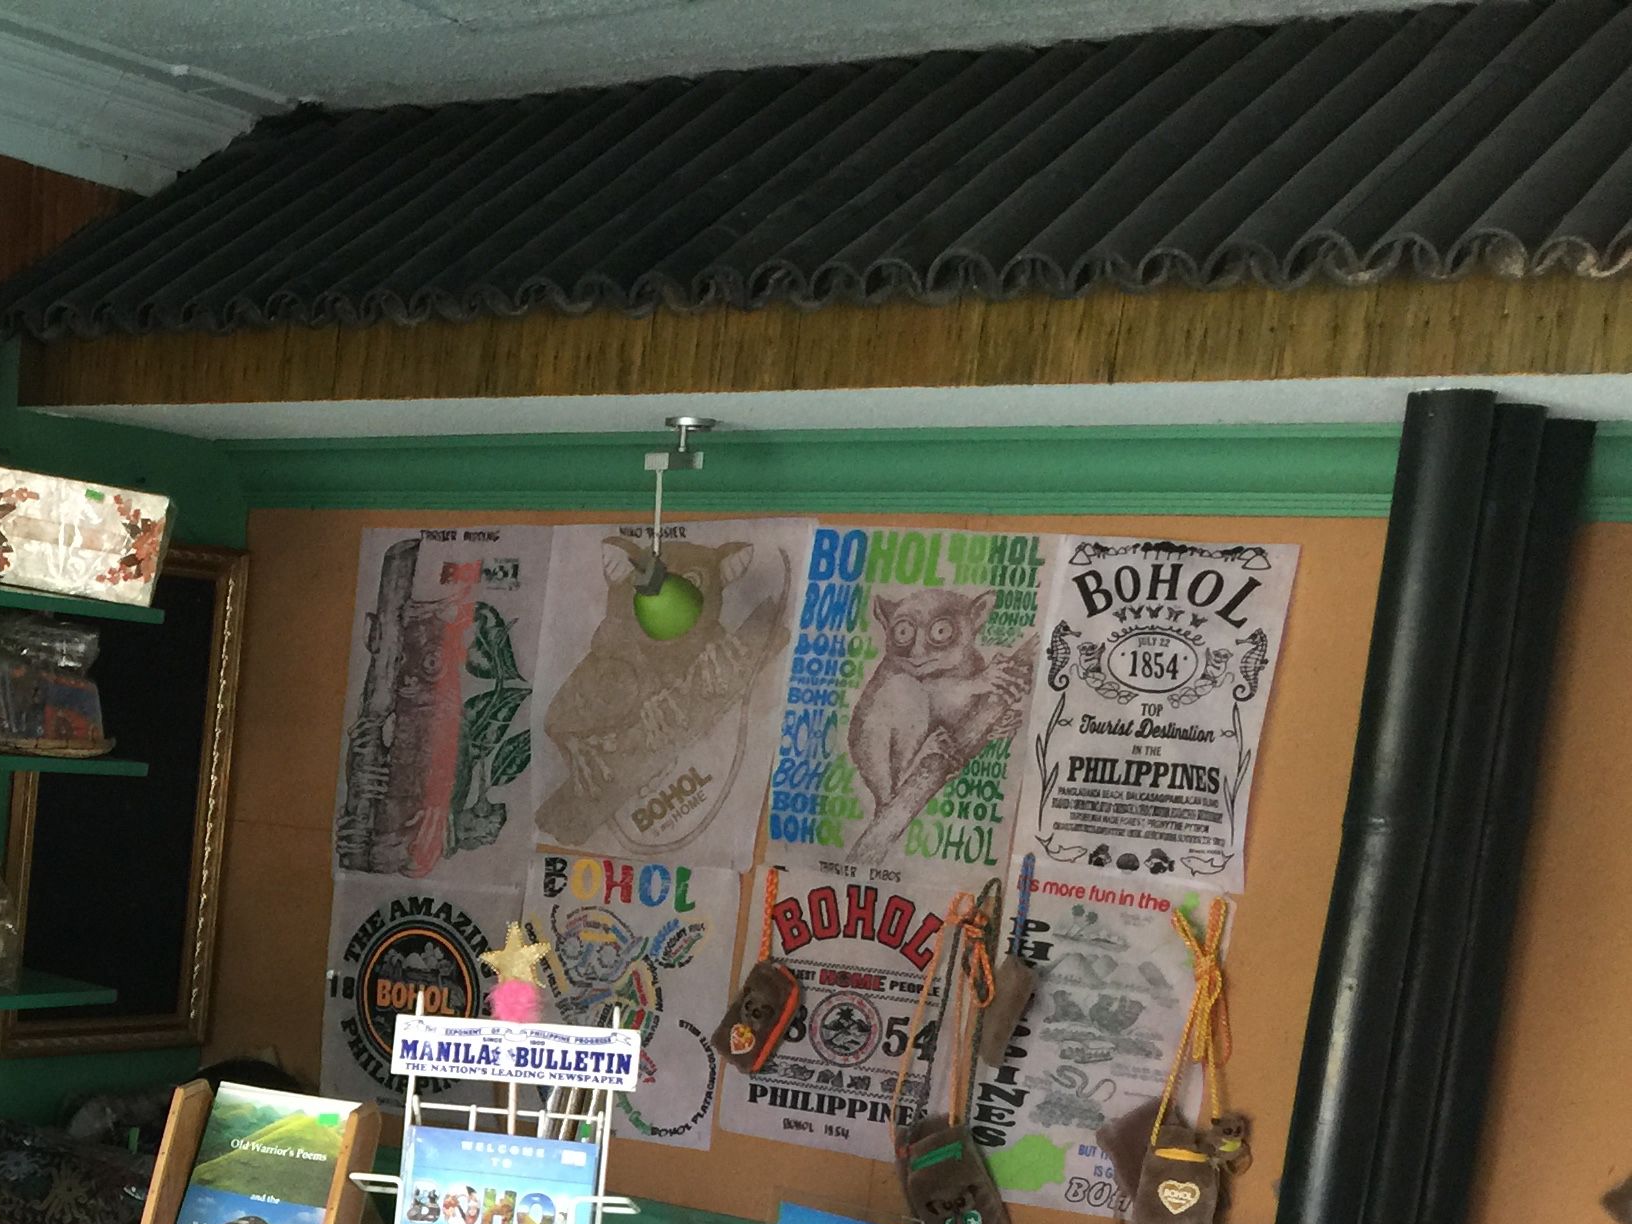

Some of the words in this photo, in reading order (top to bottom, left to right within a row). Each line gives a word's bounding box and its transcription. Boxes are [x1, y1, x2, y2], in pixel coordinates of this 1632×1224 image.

[808, 528, 945, 587] BOHOL
[1072, 563, 1263, 629] BOHOL
[1129, 650, 1179, 680] 1854
[1140, 703, 1164, 717] TOP
[1079, 713, 1134, 735] Tourist
[1134, 718, 1216, 743] Destination
[1067, 755, 1221, 795] PHILIPPINES
[632, 766, 713, 833] BOHOL
[905, 818, 999, 866] BOHOL
[543, 857, 696, 913] BOHOL
[1042, 879, 1085, 899] more
[1088, 884, 1116, 905] fun
[1120, 889, 1136, 906] in
[1139, 891, 1171, 912] the
[343, 910, 386, 963] THE
[773, 884, 944, 971] BOHOL
[376, 978, 455, 1015] BOHOL
[819, 968, 887, 991] HOME
[889, 980, 941, 998] PEOPLE
[399, 1039, 492, 1064] MANILA
[514, 1047, 633, 1075] BULLETIN
[405, 1062, 429, 1073] THE
[431, 1064, 488, 1076] NATION'S
[491, 1067, 545, 1081] LEADING
[548, 1071, 624, 1086] NEWSPAPER
[783, 1117, 814, 1133] BOHOL
[230, 1138, 250, 1151] Old
[251, 1142, 294, 1157] Warrior's
[295, 1148, 327, 1162] Poems
[460, 1140, 545, 1158] WELCOME
[490, 1156, 513, 1169] TO
[1078, 1144, 1097, 1157] BUT
